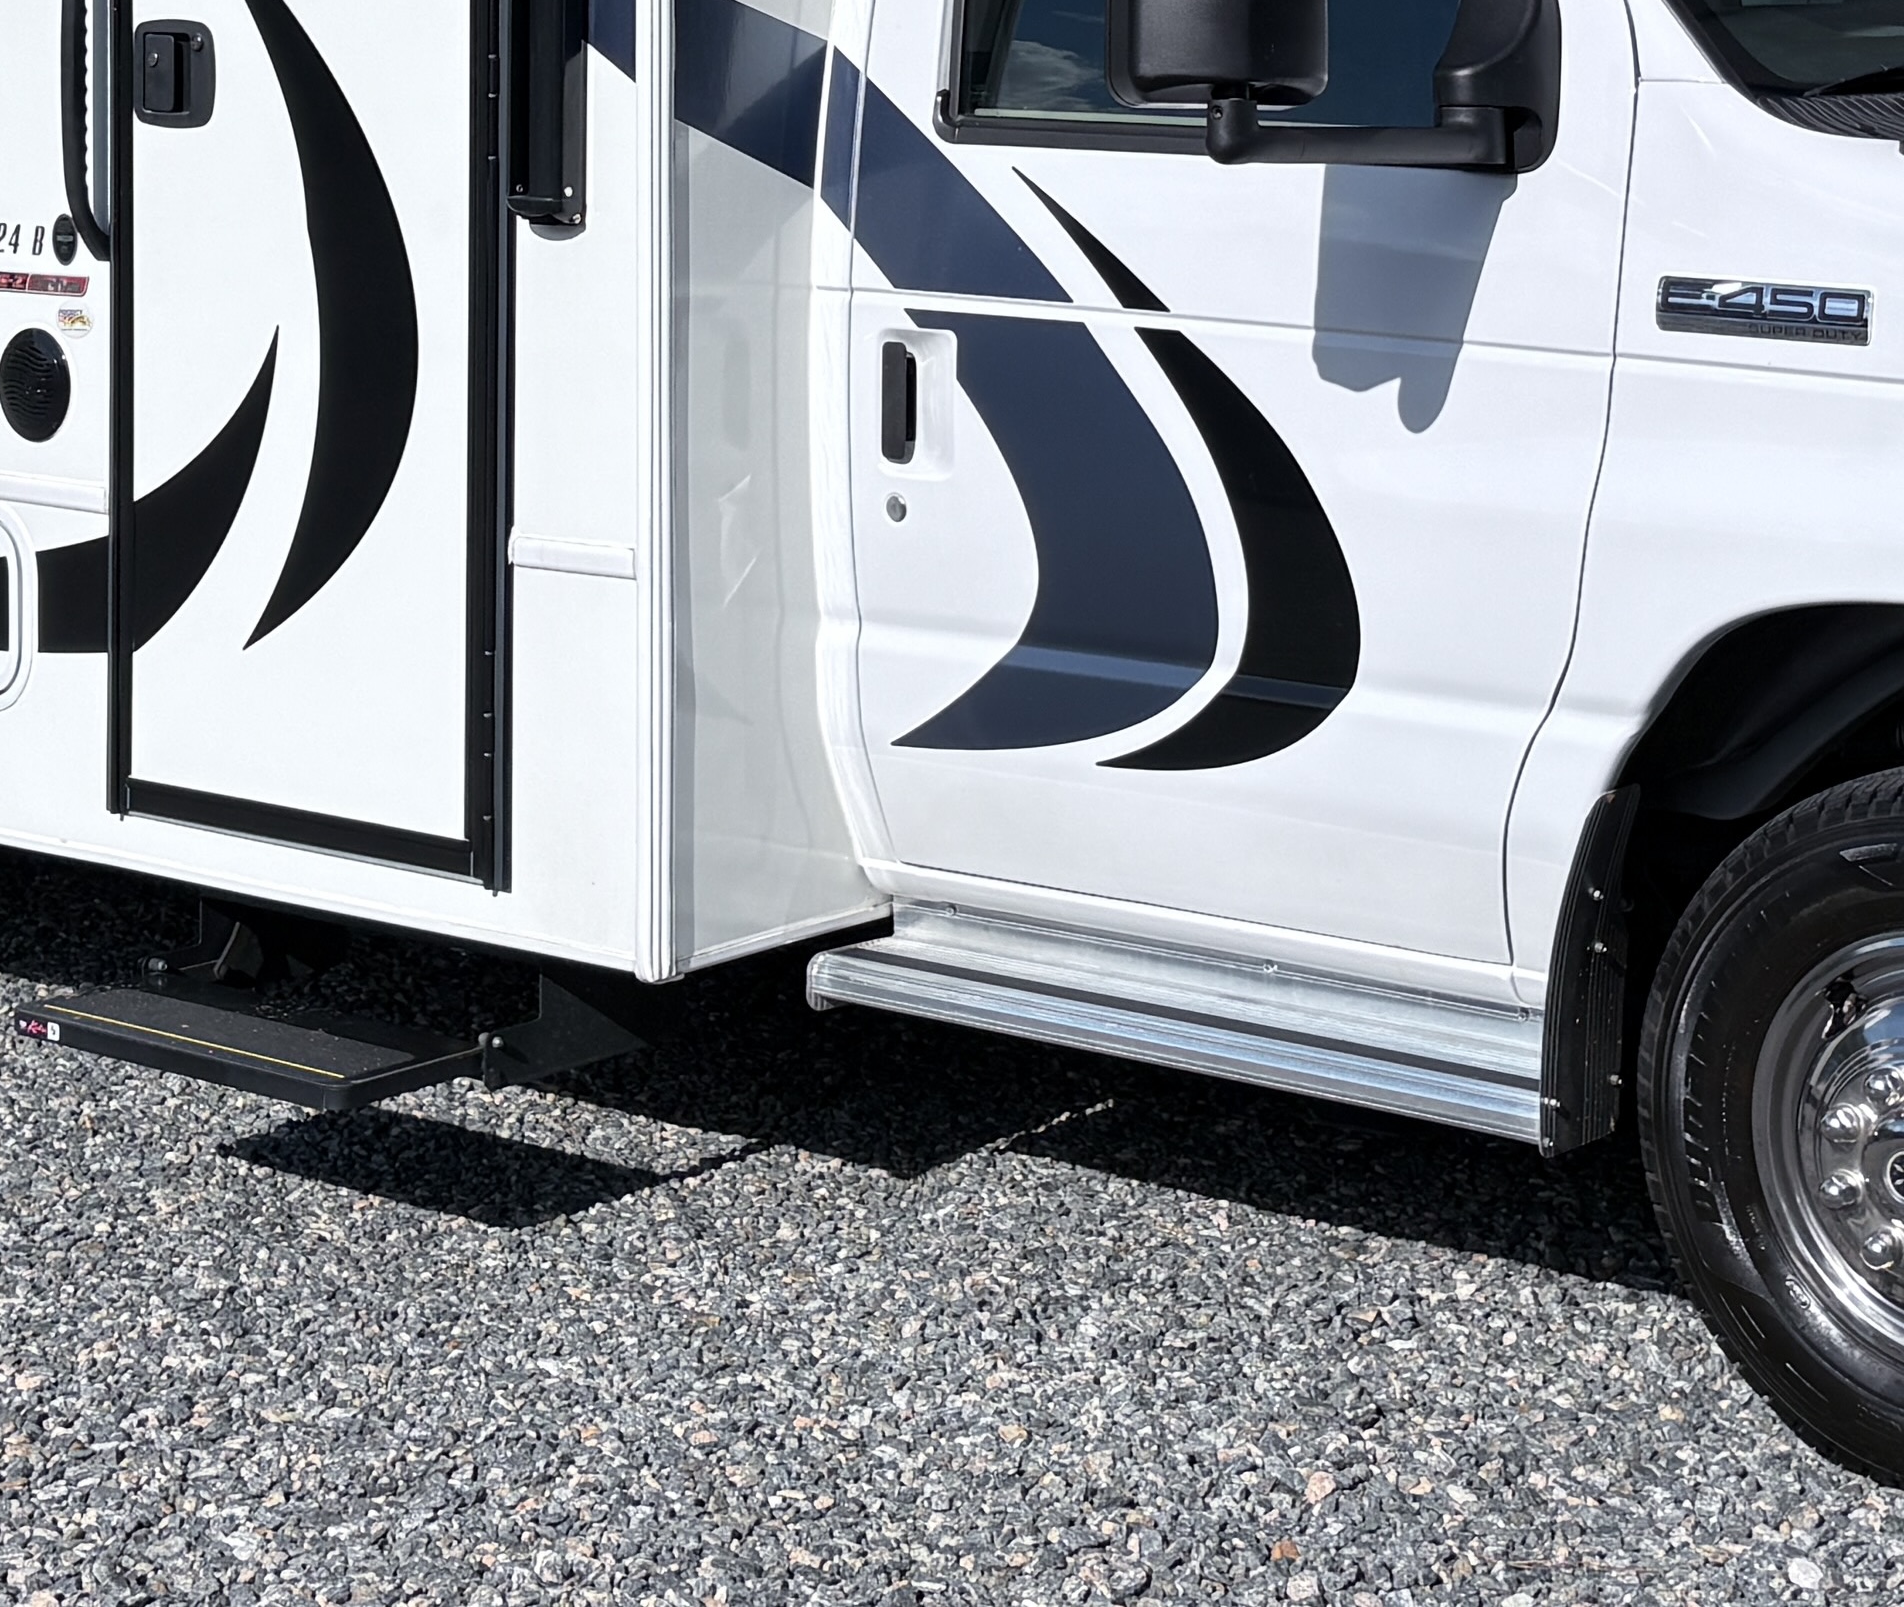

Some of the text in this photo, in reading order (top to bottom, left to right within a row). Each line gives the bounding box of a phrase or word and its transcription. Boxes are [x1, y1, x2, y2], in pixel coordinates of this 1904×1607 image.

[31, 225, 46, 256] B
[1748, 322, 1865, 342] SUPER DUTY
